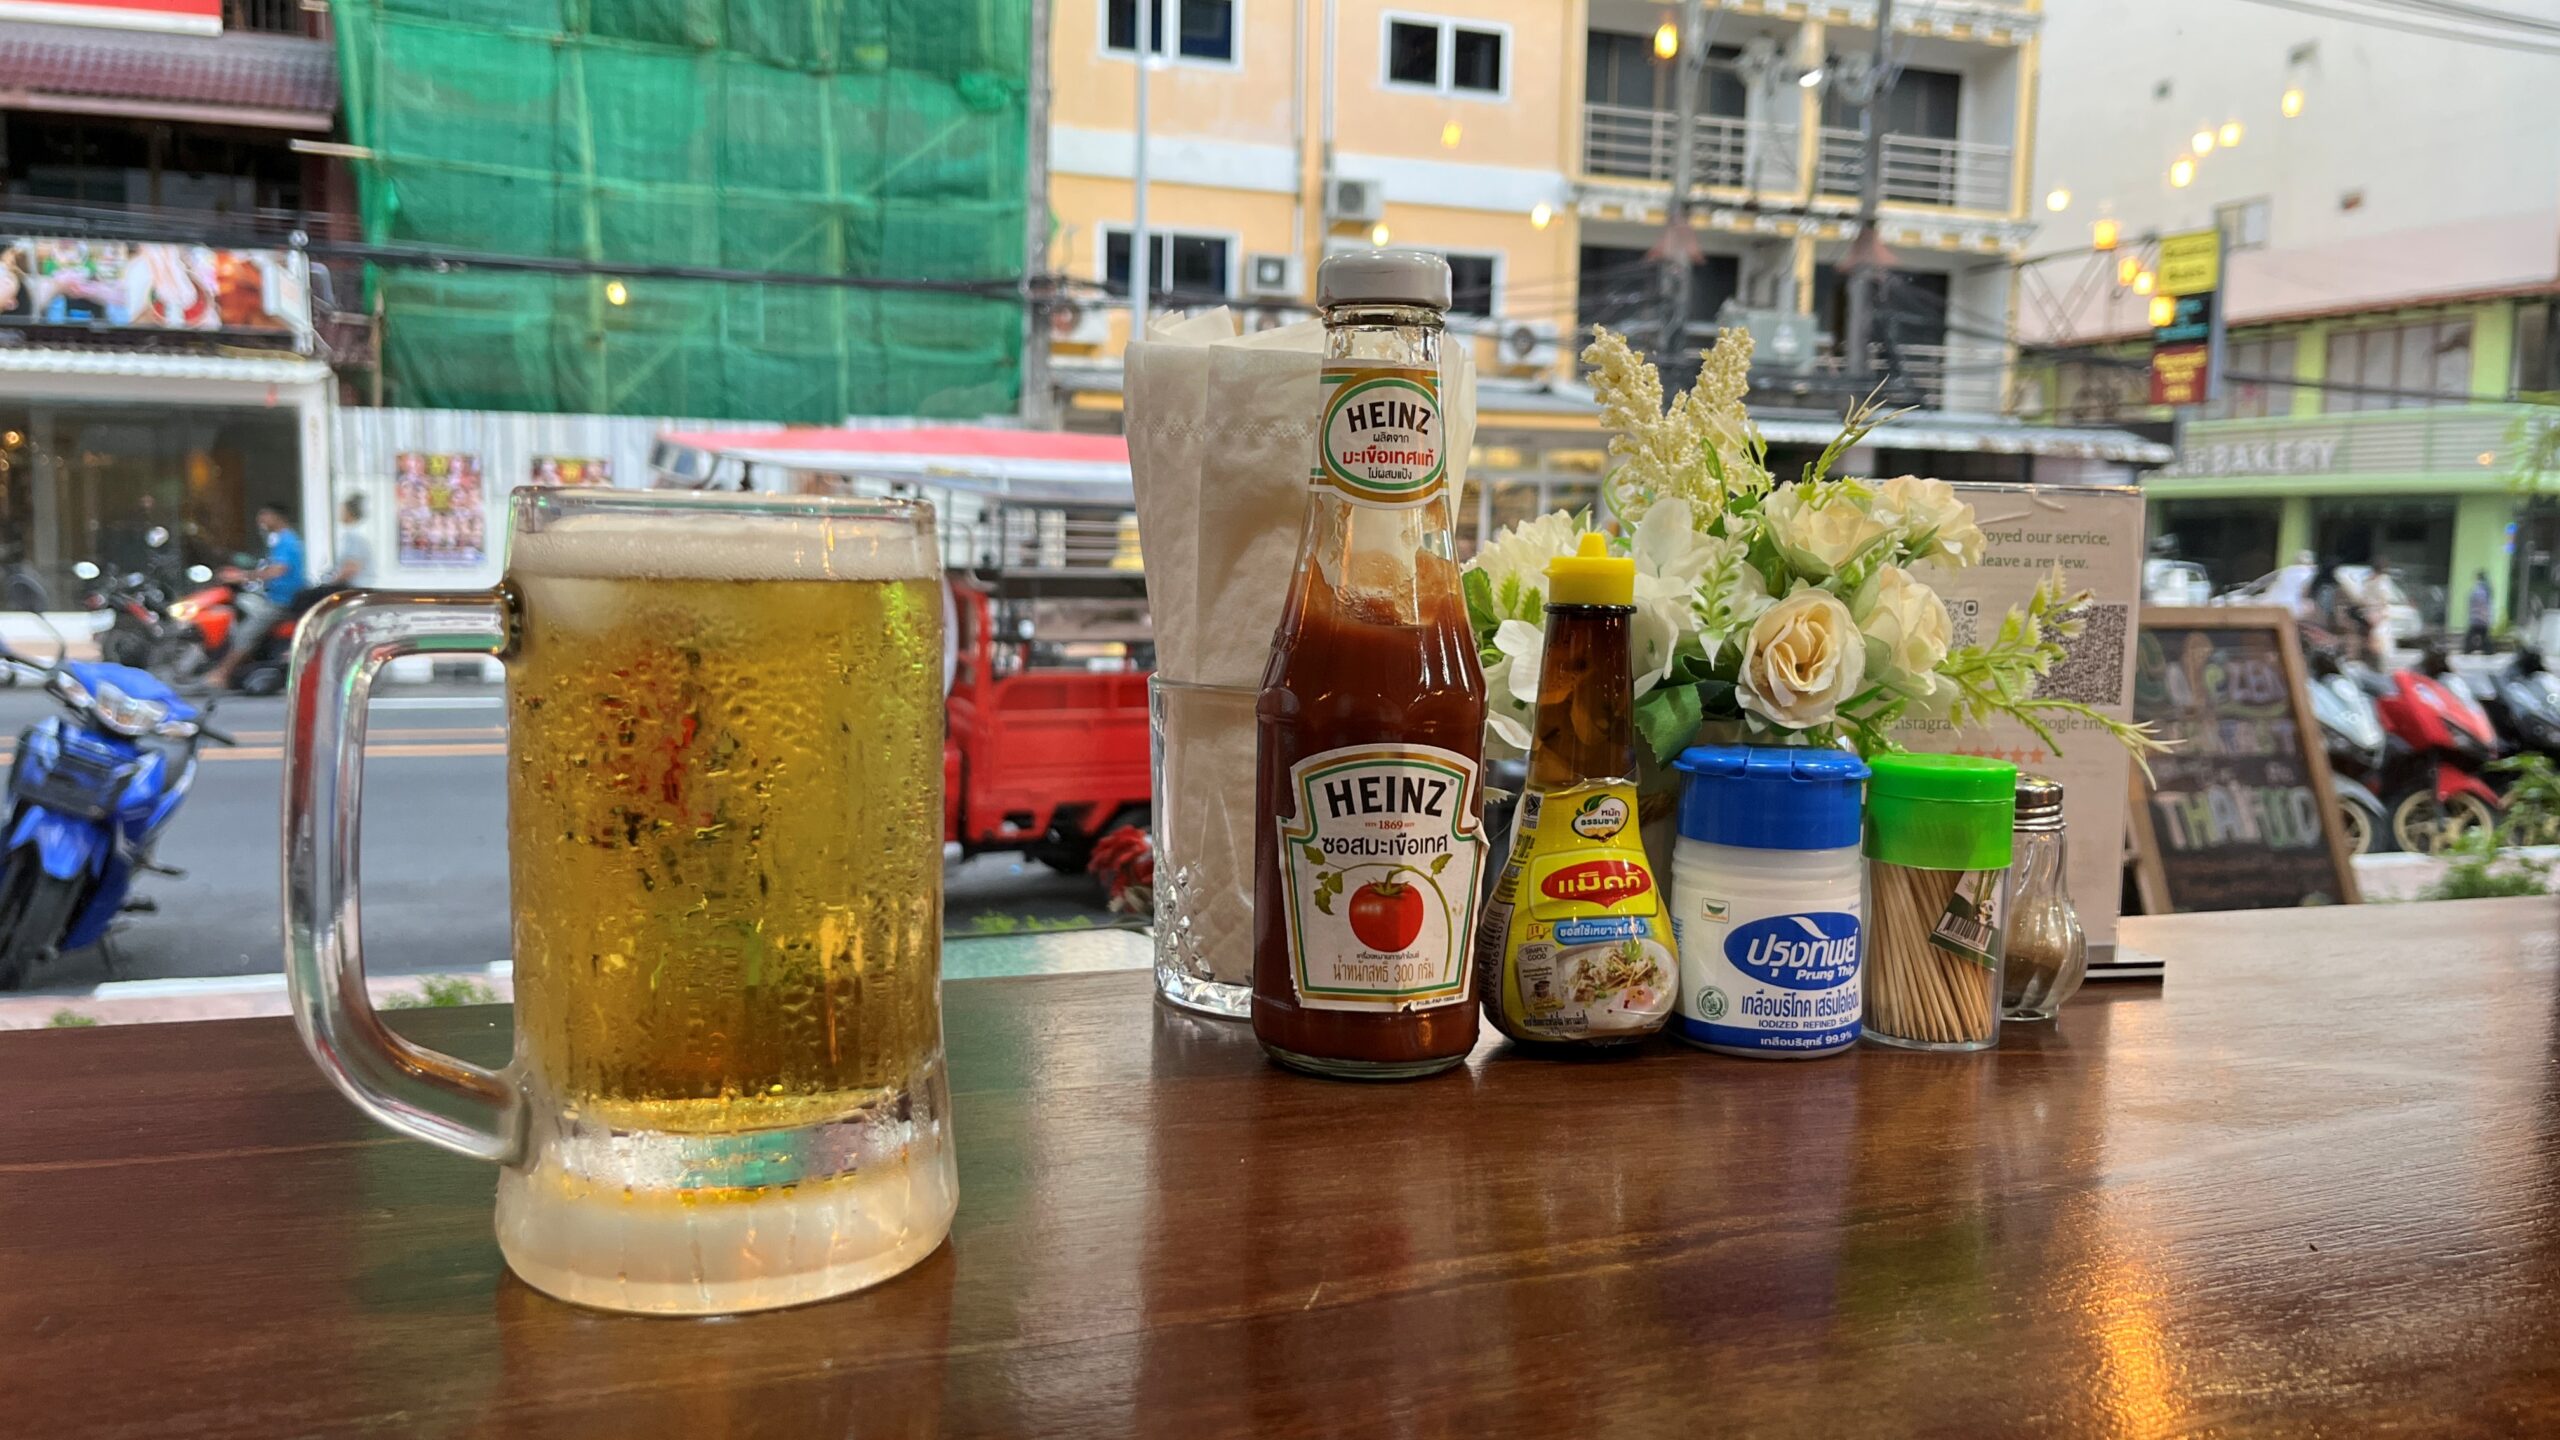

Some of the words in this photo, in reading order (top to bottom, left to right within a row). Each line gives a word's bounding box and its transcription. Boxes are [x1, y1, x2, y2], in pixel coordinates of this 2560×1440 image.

[1346, 401, 1431, 435] HEINZ
[1373, 431, 1410, 443] ผลิตจาก
[1343, 444, 1434, 467] มะเขือเทศแท้
[2212, 441, 2336, 474] BAKERY
[1368, 467, 1413, 480] ไม่ผสมแป้ง
[2027, 533, 2053, 543] our
[2056, 531, 2110, 546] service,
[1982, 554, 2020, 567] leave
[2024, 558, 2031, 568] a
[2038, 714, 2079, 734] oogle
[1324, 776, 1447, 818] HEINZ
[1379, 820, 1403, 830] 1869
[1321, 832, 1447, 856] ซอสมะเขือเทศ
[1394, 963, 1414, 981] 300
[1418, 958, 1435, 979] กรัม
[1796, 969, 1834, 981] Prung
[1837, 963, 1855, 977] Thip
[1741, 989, 1811, 1018] เกลือบริโภค
[1759, 1019, 1799, 1029] IODIZED
[1803, 1019, 1837, 1029] REFINED
[1839, 1013, 1854, 1024] SALT
[1825, 1031, 1852, 1044] 99.9%
